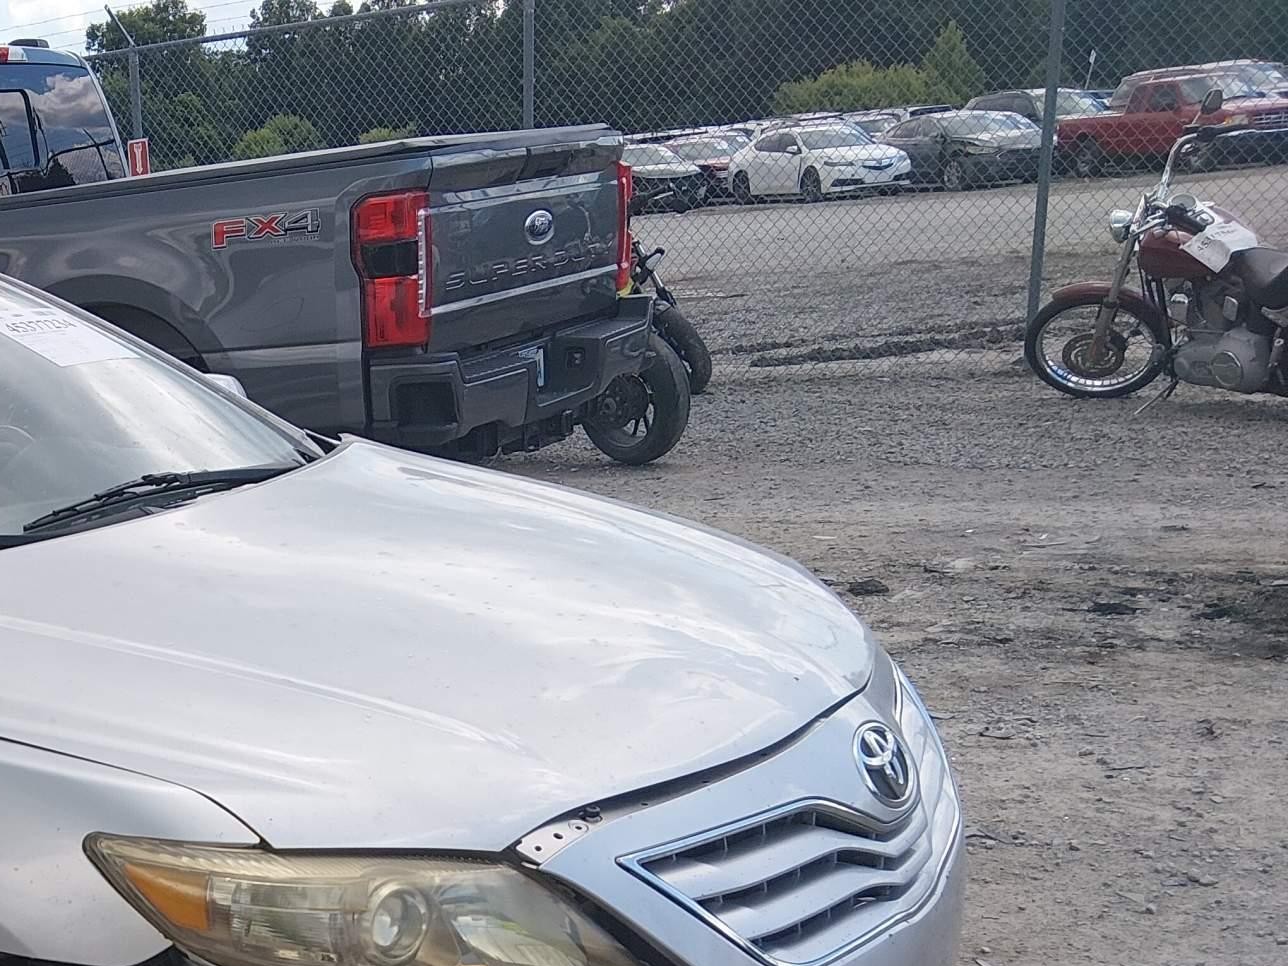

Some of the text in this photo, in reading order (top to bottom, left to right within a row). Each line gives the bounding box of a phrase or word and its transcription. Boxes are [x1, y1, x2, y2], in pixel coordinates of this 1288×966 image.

[212, 208, 321, 250] FX4
[445, 255, 548, 291] SUPER
[4, 319, 77, 334] 45377234
